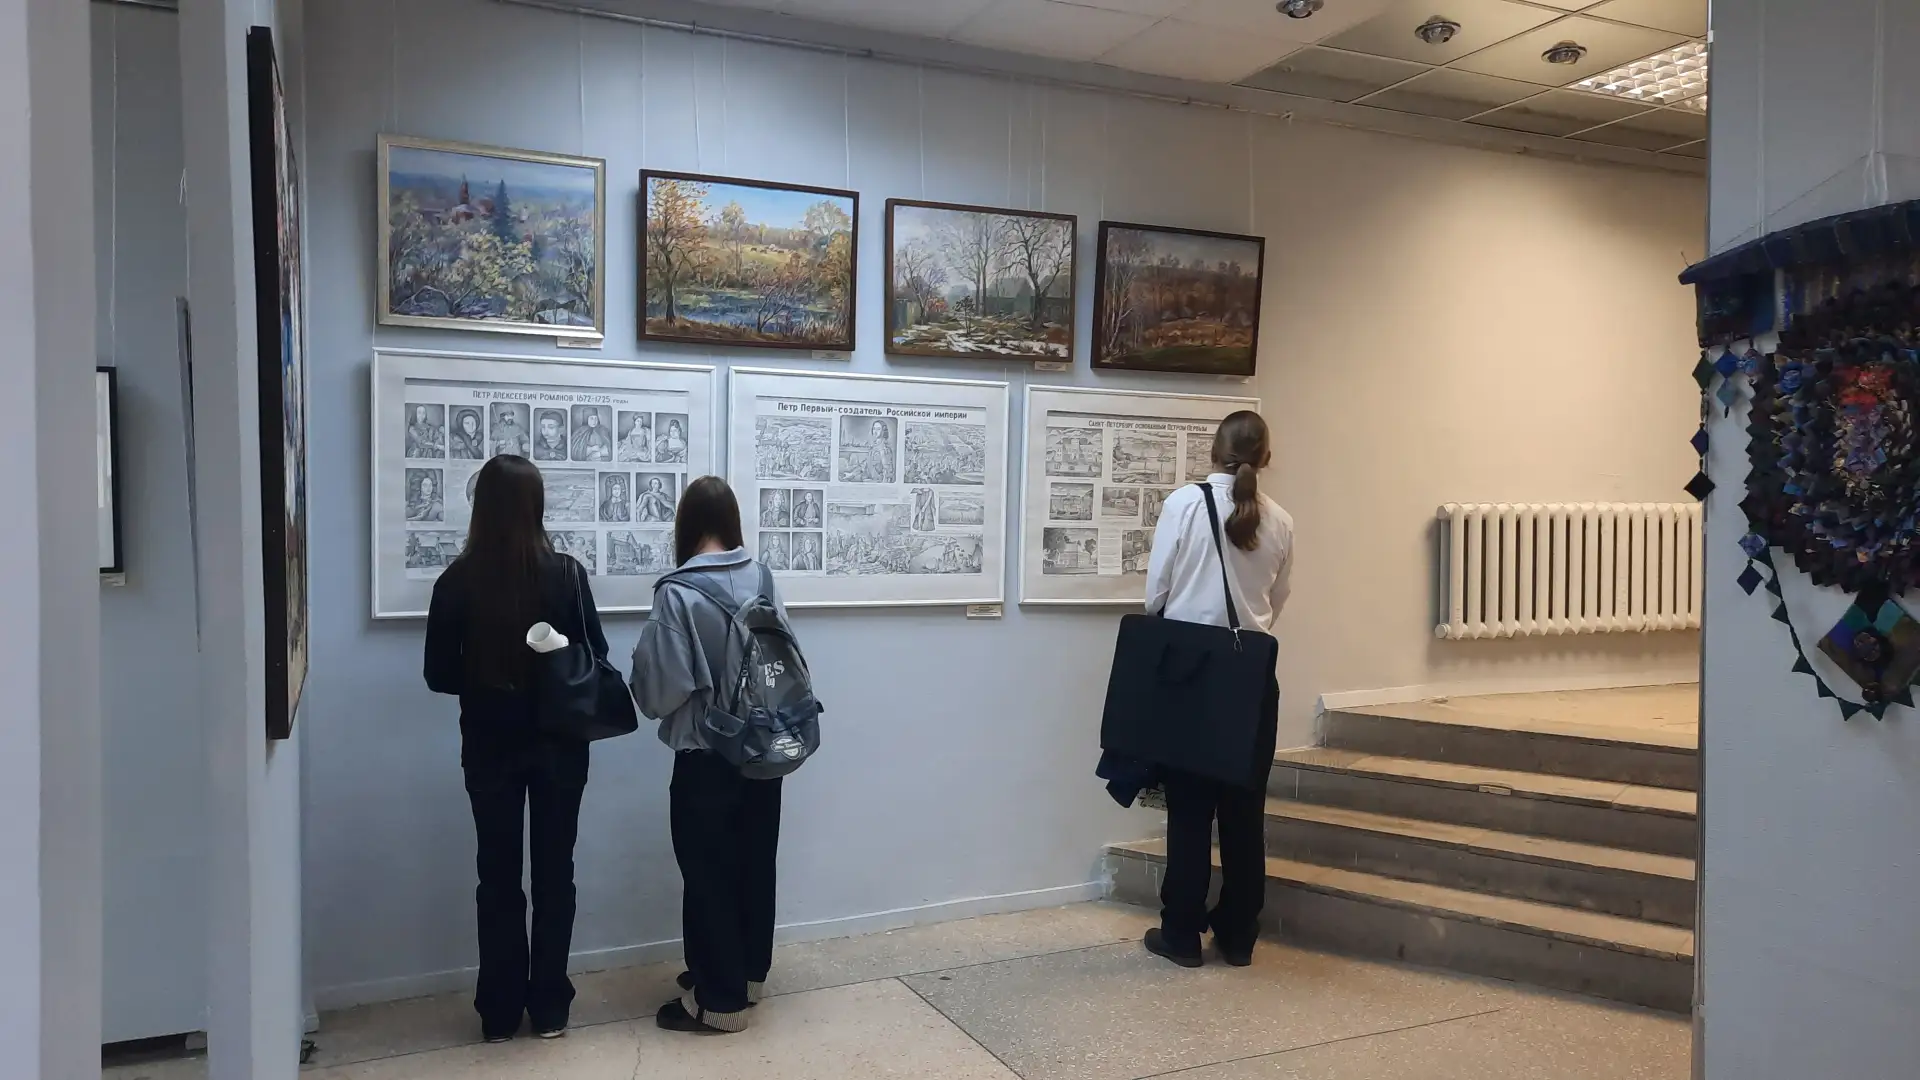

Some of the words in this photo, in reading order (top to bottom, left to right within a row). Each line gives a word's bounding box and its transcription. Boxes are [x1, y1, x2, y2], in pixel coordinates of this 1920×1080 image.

[493, 391, 537, 401] АЛЕКСЕЕВИЧ
[539, 393, 574, 402] РОМАНОВ
[576, 394, 611, 403] 1672-1725
[777, 402, 798, 412] Петр
[886, 407, 931, 418] Российской
[934, 411, 968, 420] империи
